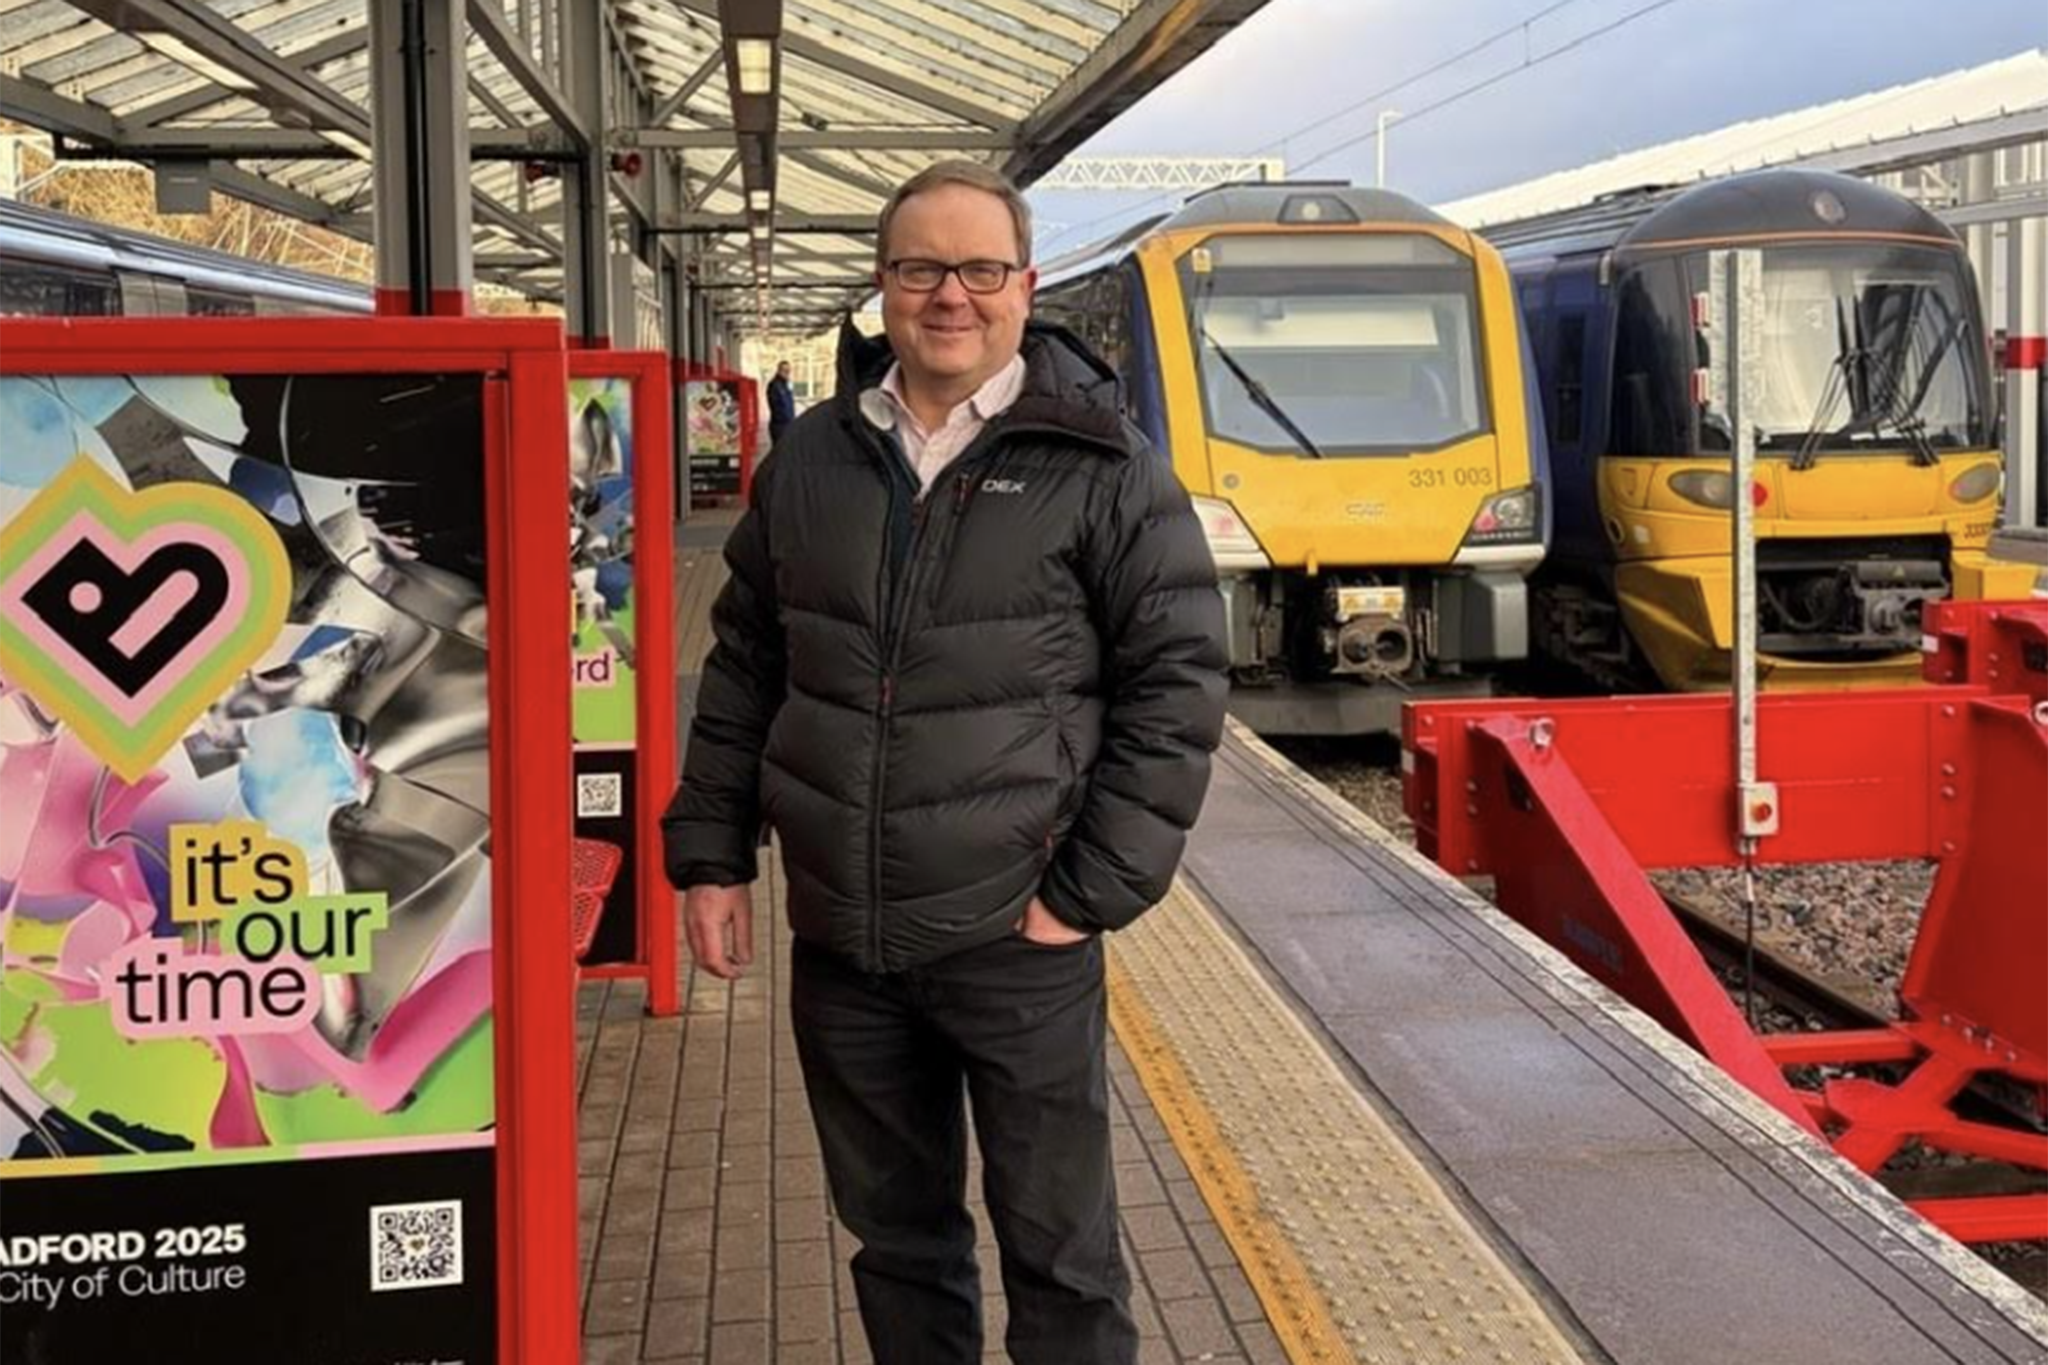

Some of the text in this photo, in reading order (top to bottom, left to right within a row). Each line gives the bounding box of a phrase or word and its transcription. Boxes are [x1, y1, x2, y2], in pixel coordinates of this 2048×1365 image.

[1408, 467, 1493, 488] 331 003
[571, 651, 610, 682] rd
[185, 837, 294, 907] it’s
[235, 906, 373, 964] our
[115, 952, 307, 1024] time
[154, 1223, 248, 1259] 2025
[72, 1267, 111, 1300] of
[118, 1262, 247, 1297] Culture
